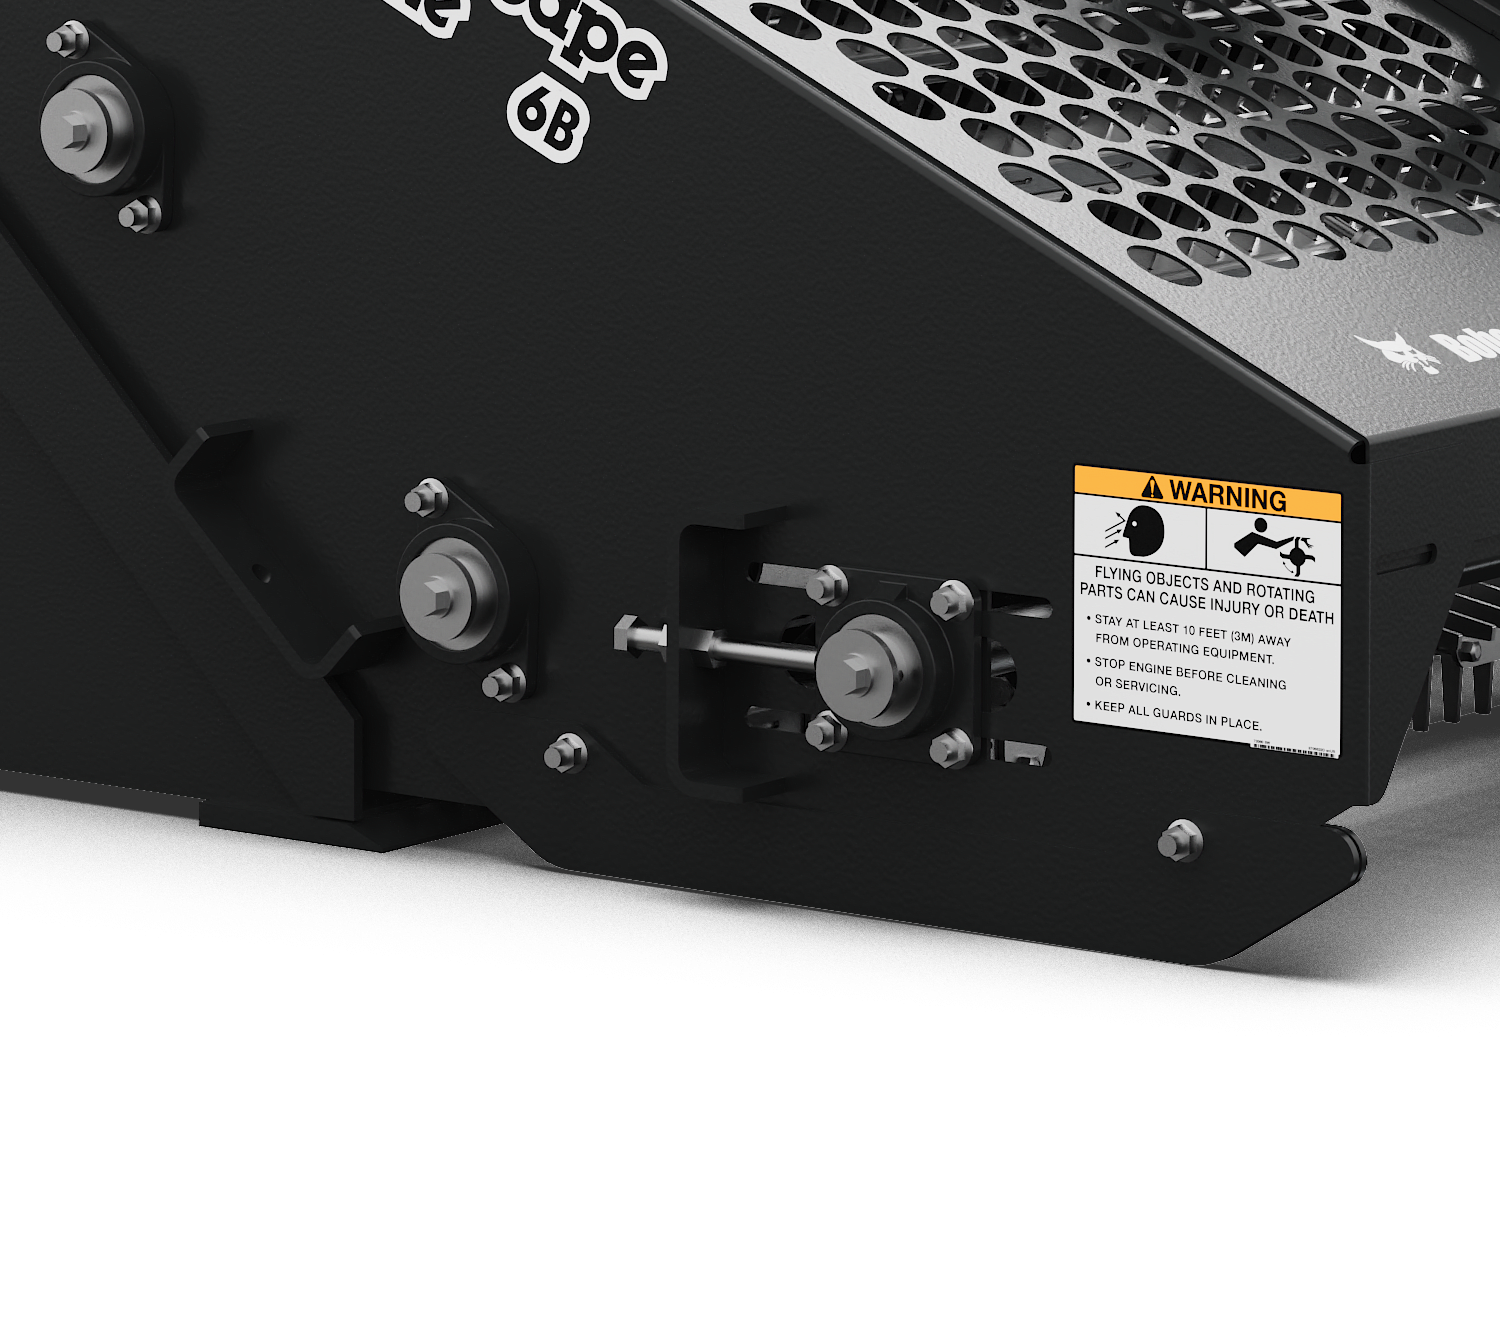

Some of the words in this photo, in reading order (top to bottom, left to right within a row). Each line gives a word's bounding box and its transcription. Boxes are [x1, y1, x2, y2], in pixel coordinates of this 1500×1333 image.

[516, 84, 582, 153] 6B
[1169, 479, 1287, 512] WARNING
[1096, 566, 1141, 582] FLYING
[1146, 571, 1209, 590] OBJECTS
[1213, 580, 1242, 594] AND
[1246, 583, 1315, 603] ROTATING
[1080, 582, 1122, 599] PARTS
[1127, 588, 1154, 603] CAN
[1160, 592, 1205, 609] CAUSE
[1210, 598, 1260, 615] INJURY
[1265, 605, 1284, 618] OR
[1290, 608, 1334, 624] DEATH
[1095, 614, 1122, 626] STAY
[1126, 618, 1140, 628] AT
[1143, 621, 1179, 633] LEAST
[1184, 626, 1195, 635] 10
[1199, 627, 1227, 639] FEET
[1231, 631, 1254, 644] (3M)
[1258, 635, 1291, 647] AWAY
[1095, 634, 1129, 646] FROM
[1133, 638, 1199, 654] OPERATING
[1203, 647, 1275, 664] EQUIPMENT.
[1095, 657, 1125, 669] STOP
[1129, 662, 1172, 676] ENGINE
[1176, 667, 1222, 682] BEFORE
[1227, 674, 1287, 690] CLEANING
[1095, 677, 1112, 687] OR
[1116, 679, 1181, 696] SERVICING.
[1095, 701, 1124, 712] KEEP
[1128, 705, 1149, 716] ALL
[1153, 708, 1202, 723] GUARDS
[1206, 715, 1217, 725] IN
[1221, 717, 1262, 731] PLACE.
